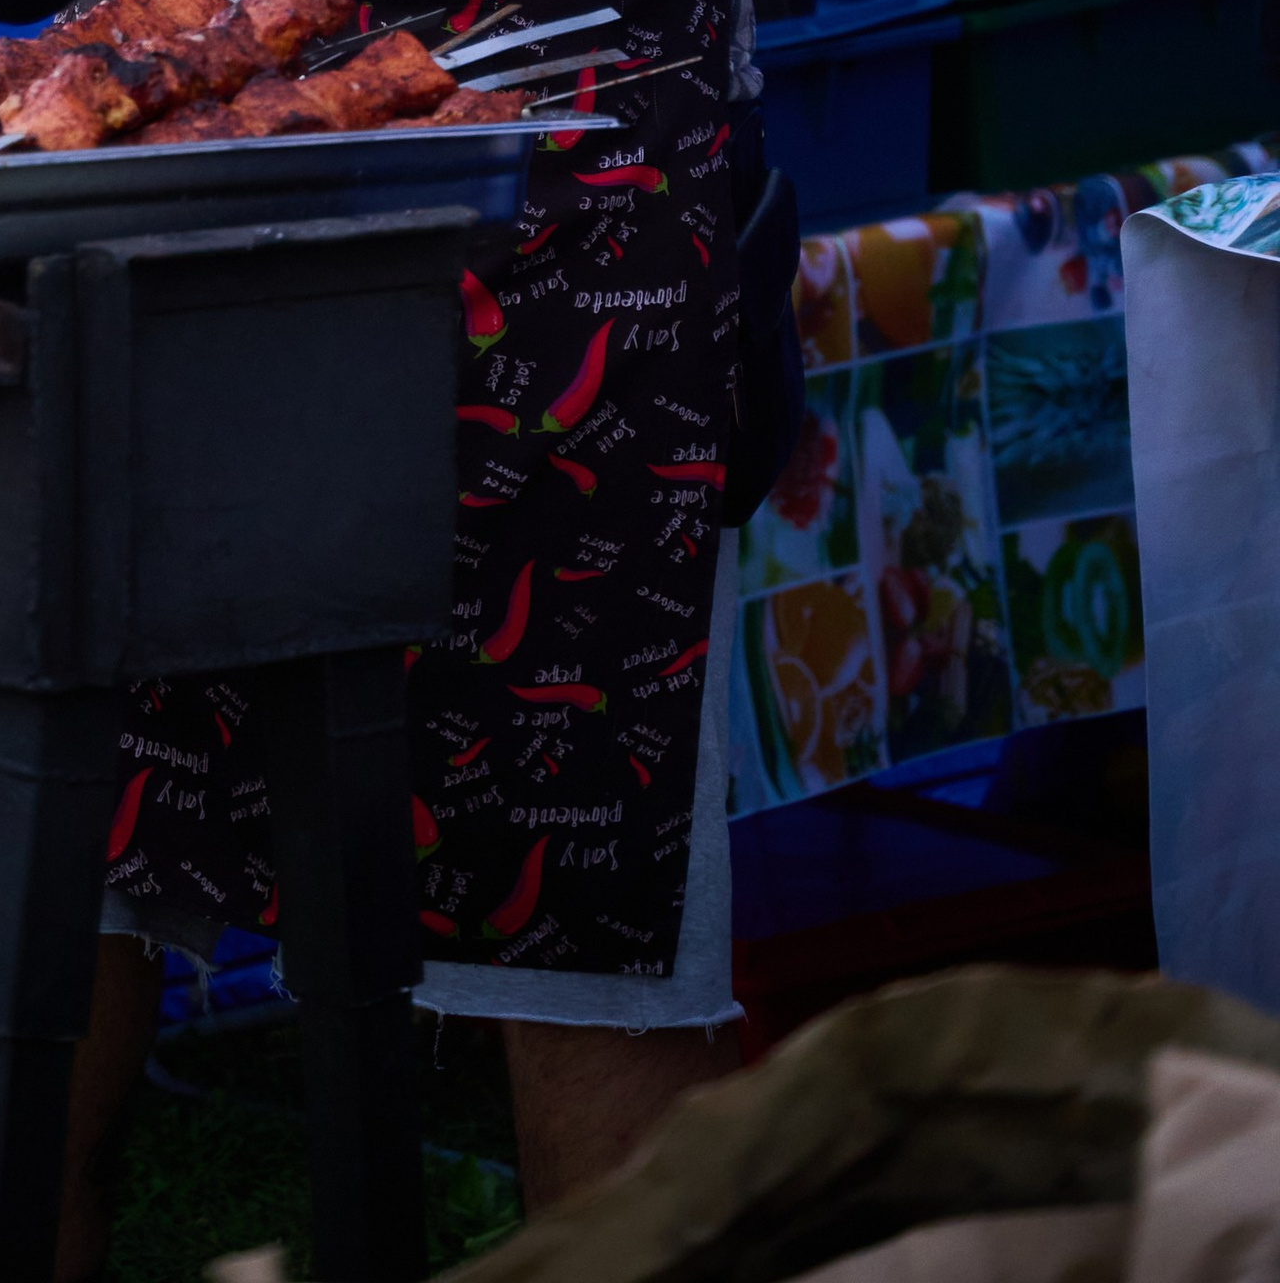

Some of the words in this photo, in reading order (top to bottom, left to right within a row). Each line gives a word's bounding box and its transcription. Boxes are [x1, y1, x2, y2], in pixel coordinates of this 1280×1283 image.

[599, 147, 644, 168] pepe
[598, 188, 635, 212] Sale
[575, 281, 686, 313] pimienta
[624, 324, 639, 349] y
[646, 321, 681, 351] Sal
[654, 395, 710, 426] poivre
[673, 443, 716, 461] pepe
[669, 485, 707, 509] Sale
[637, 586, 695, 617] poivre
[535, 665, 581, 683] pepe
[532, 706, 570, 729] Sale
[119, 733, 208, 774] pimienta
[157, 780, 172, 804] y
[178, 790, 205, 820] Sal
[510, 800, 622, 829] pimienta
[560, 841, 574, 866] y
[583, 840, 618, 871] Sal
